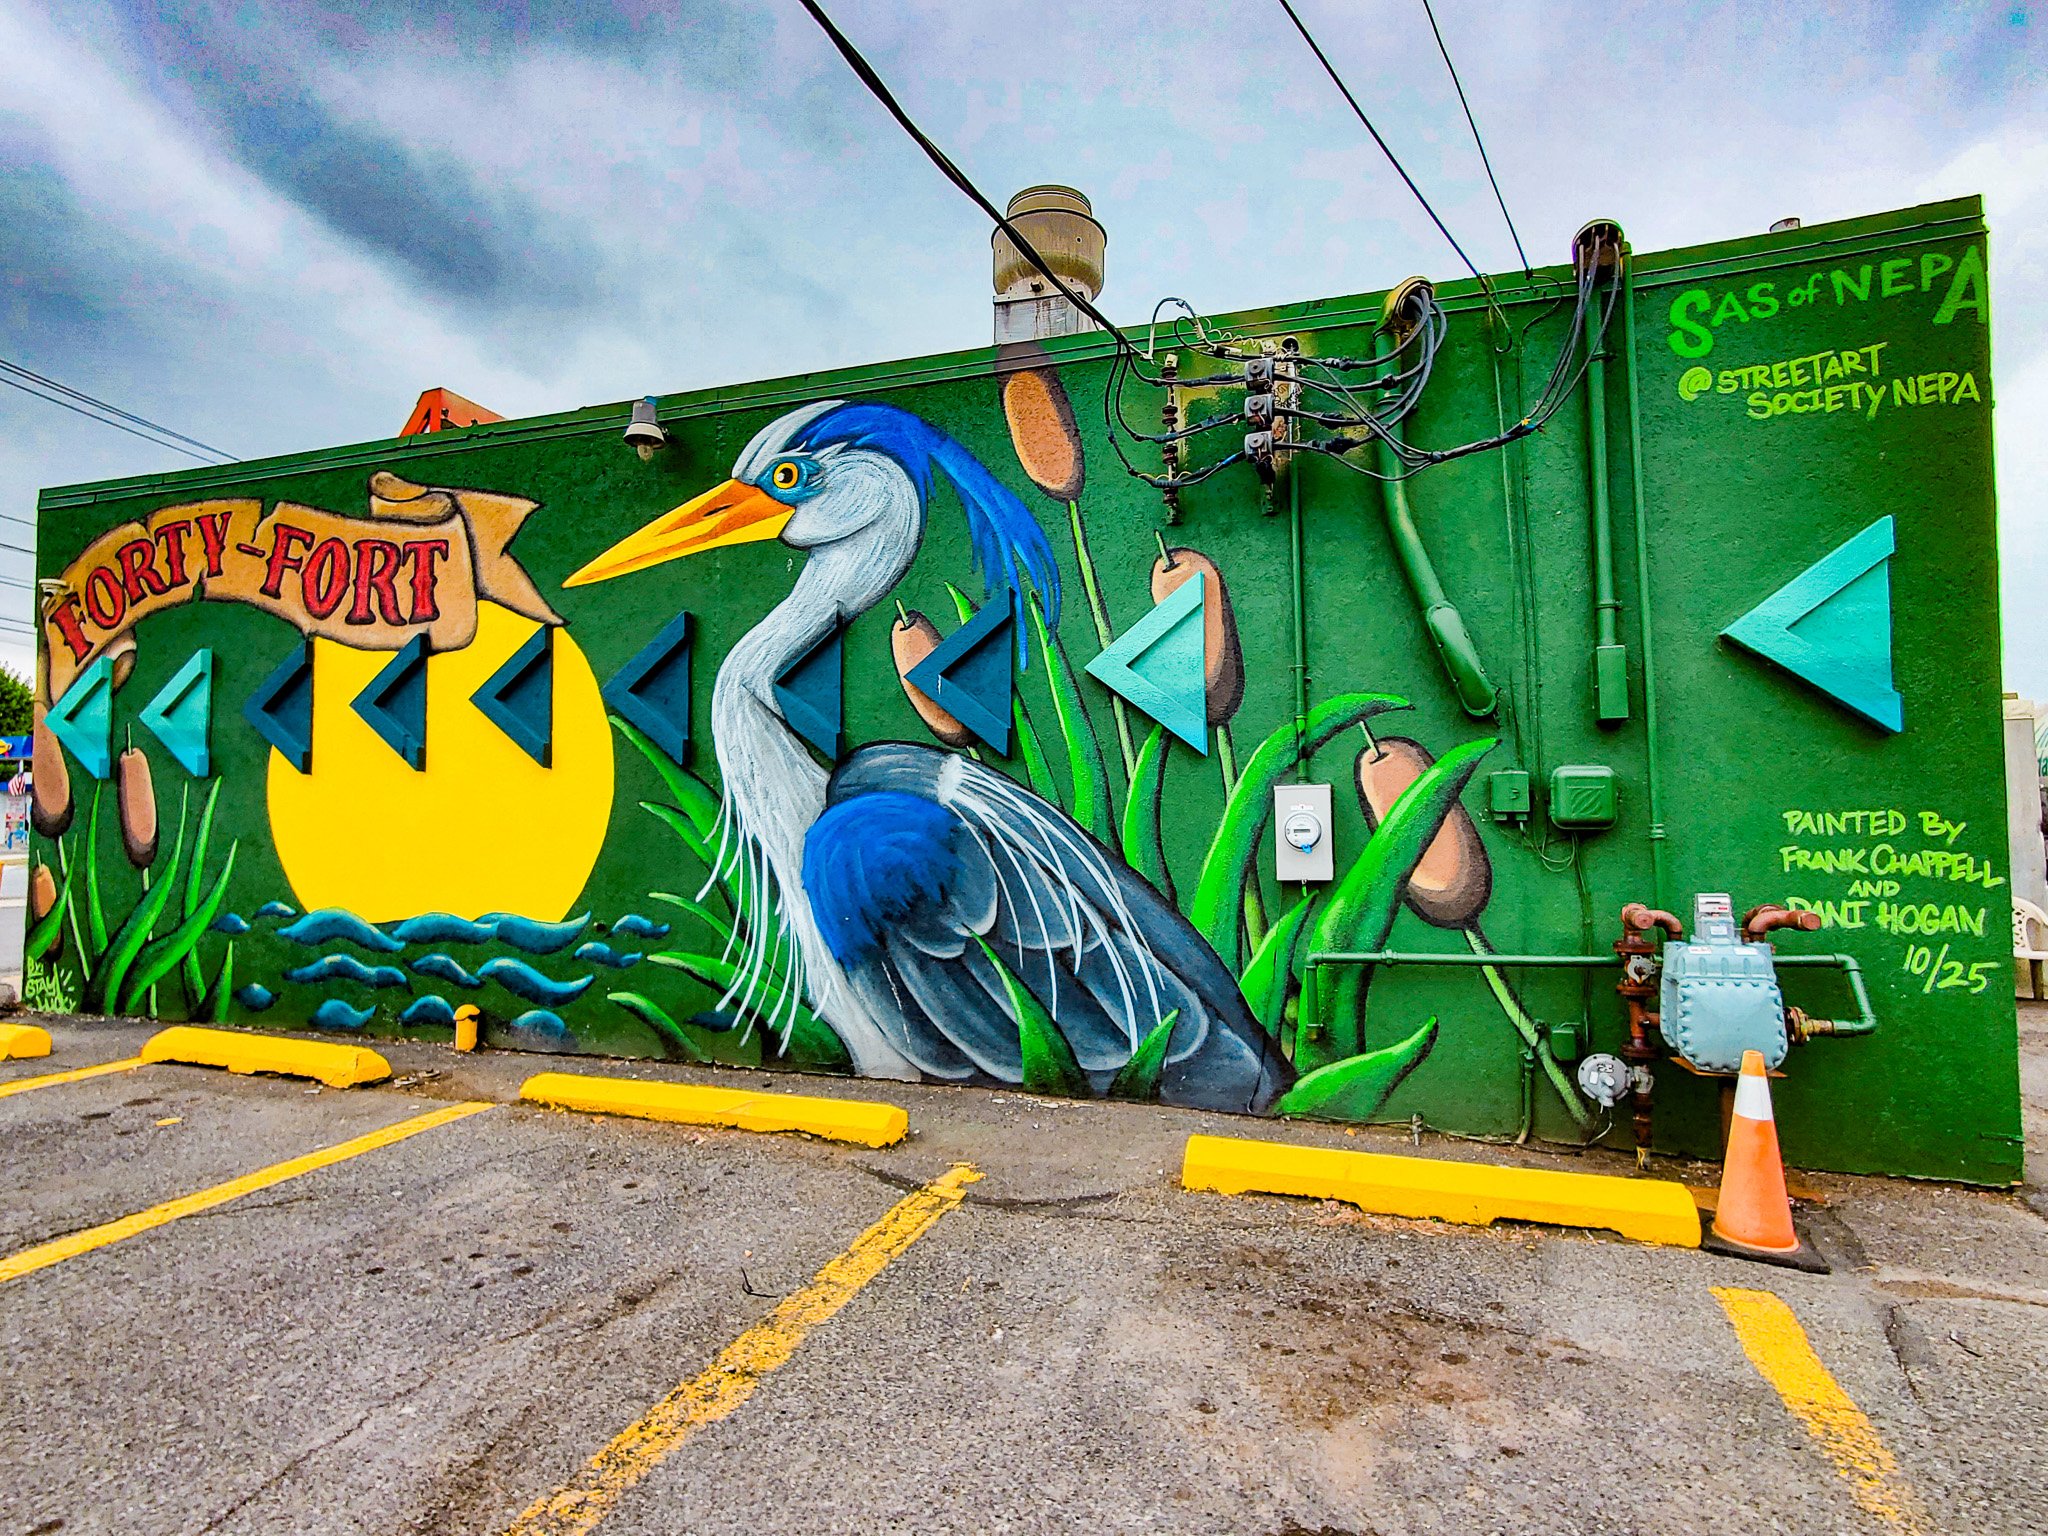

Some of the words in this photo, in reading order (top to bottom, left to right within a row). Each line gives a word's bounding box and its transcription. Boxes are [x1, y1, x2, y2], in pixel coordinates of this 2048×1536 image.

[1667, 282, 1780, 359] SAS
[1830, 245, 1988, 326] NEPA
[1678, 342, 1888, 401] @STREETART
[1746, 381, 1887, 421] SOCIETY
[1893, 372, 1981, 407] NEPA
[49, 511, 450, 666] FORTY-FORT
[1783, 810, 1907, 837] PAINTED
[1779, 845, 1870, 875] FRANK
[1847, 879, 1901, 898] AND
[1875, 900, 1987, 937] HOGAN
[1903, 943, 2001, 994] 10/25
